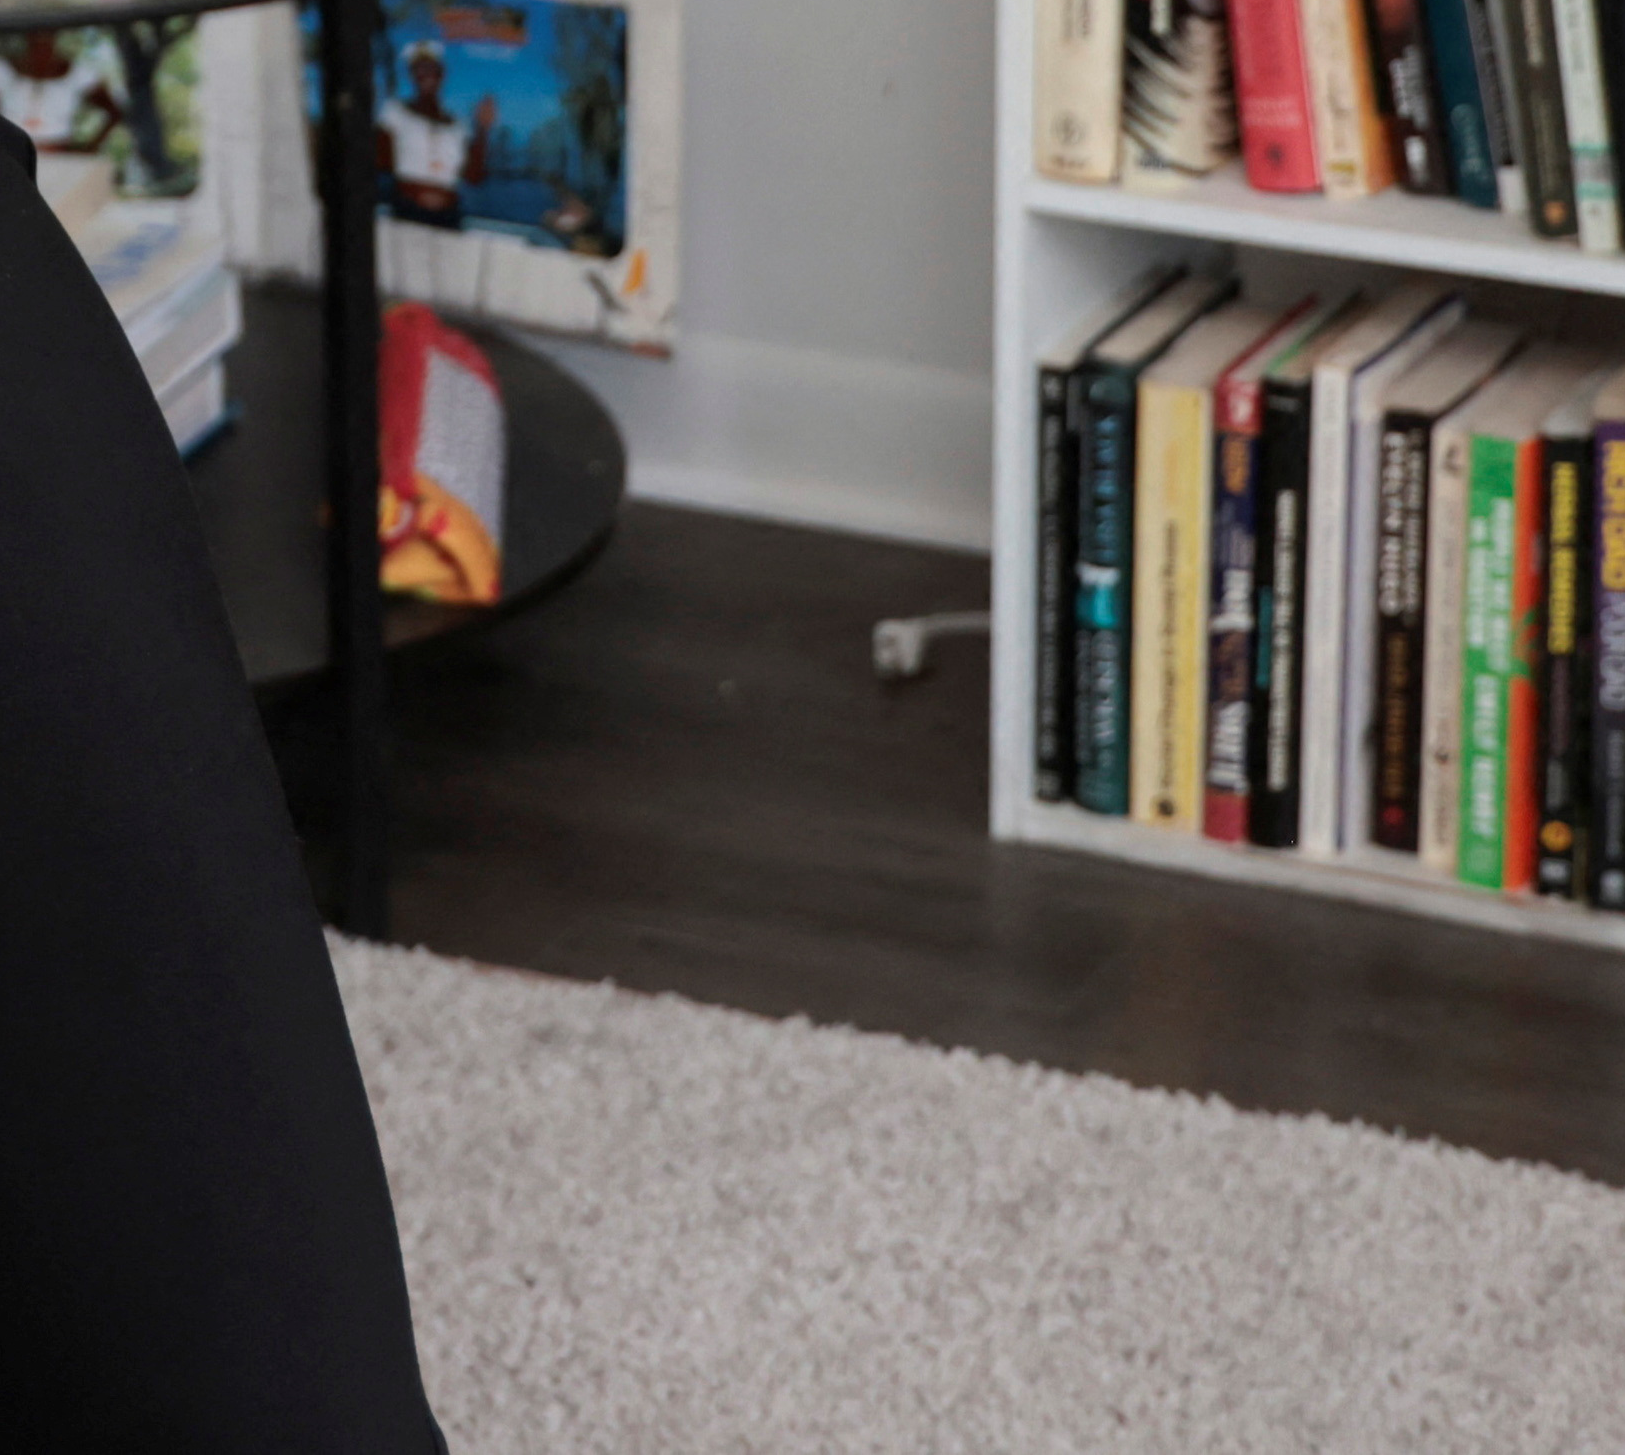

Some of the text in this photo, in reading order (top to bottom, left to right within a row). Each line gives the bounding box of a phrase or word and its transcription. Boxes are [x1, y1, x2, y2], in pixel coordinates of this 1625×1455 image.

[1379, 432, 1405, 616] EVELYN HUGO
[1486, 499, 1513, 673] PEOPLE WE MEET
[1548, 462, 1578, 654] HERBAL REMEDIES
[1471, 675, 1501, 840] EMILY HENRY
